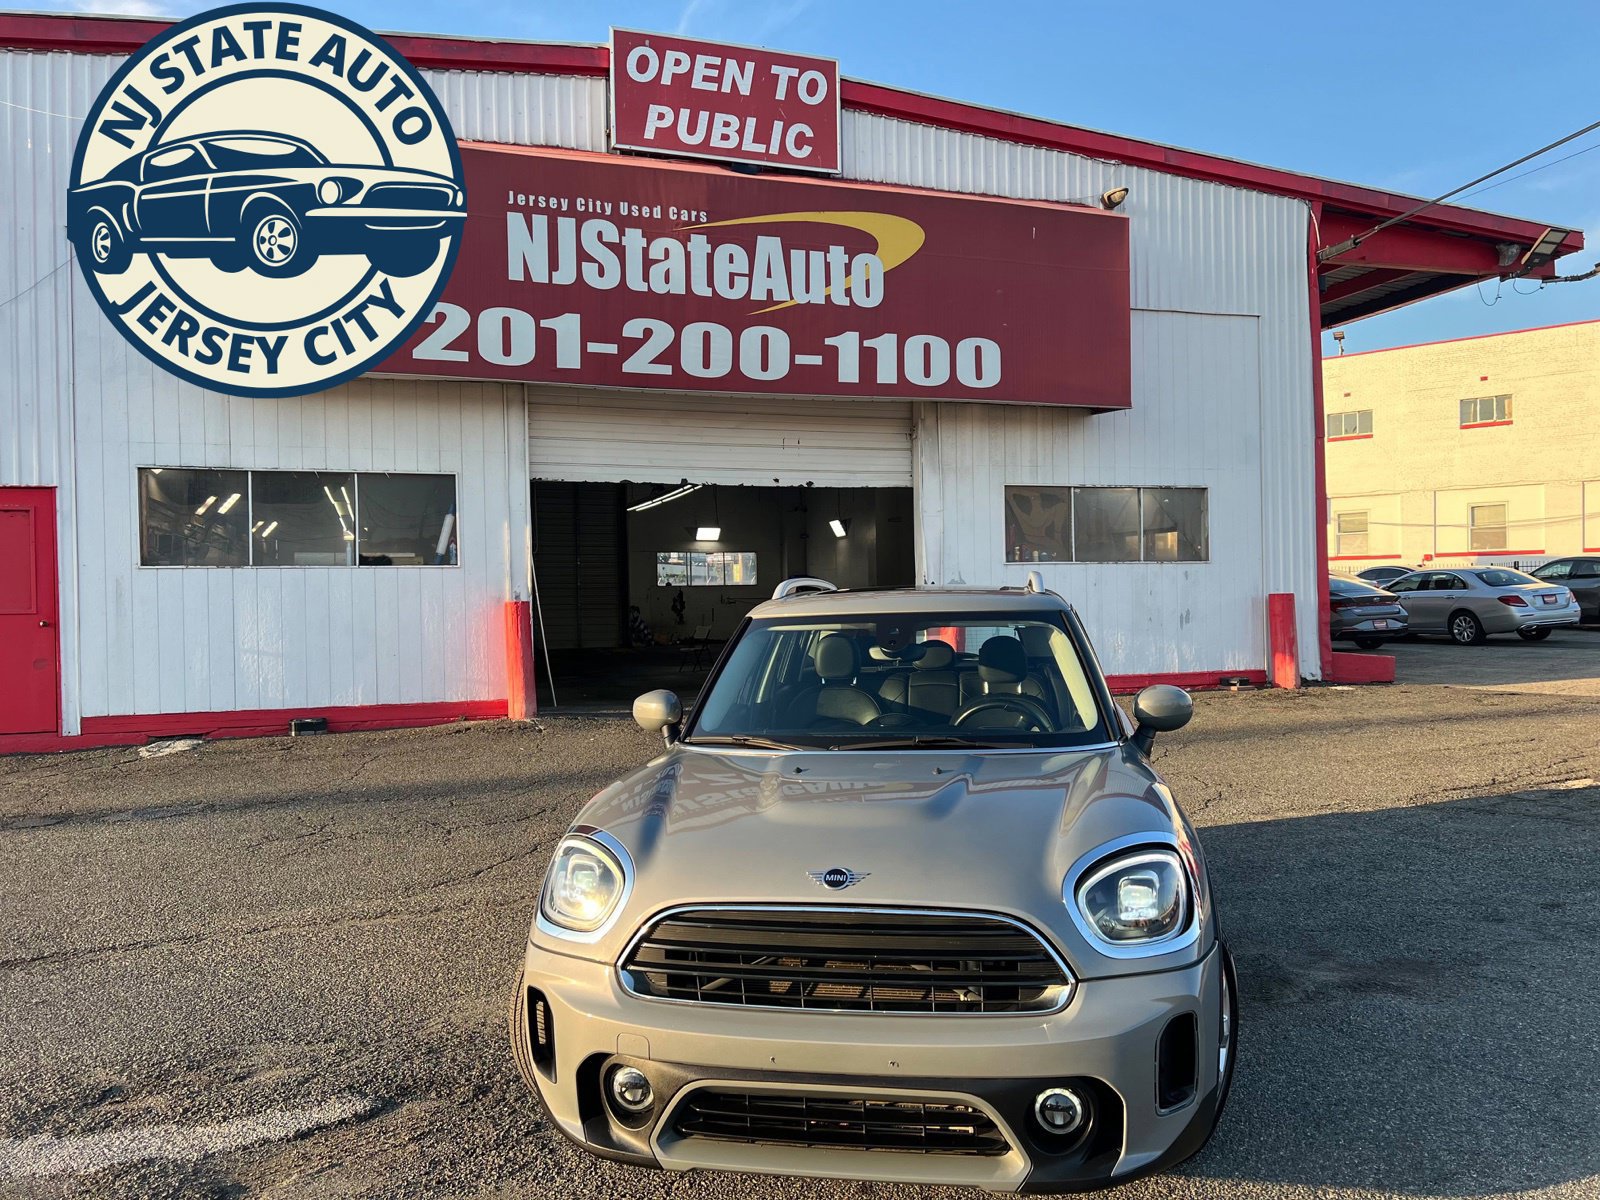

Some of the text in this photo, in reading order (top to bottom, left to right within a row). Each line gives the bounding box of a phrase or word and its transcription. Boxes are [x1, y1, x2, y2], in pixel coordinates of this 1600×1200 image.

[626, 45, 828, 106] OPEN TO
[643, 103, 814, 159] PUBLIC
[507, 190, 708, 223] Jersey City Used Cars
[506, 211, 885, 308] NJStateAuto
[412, 301, 1002, 389] 201-200-1100
[825, 874, 848, 882] MINI
